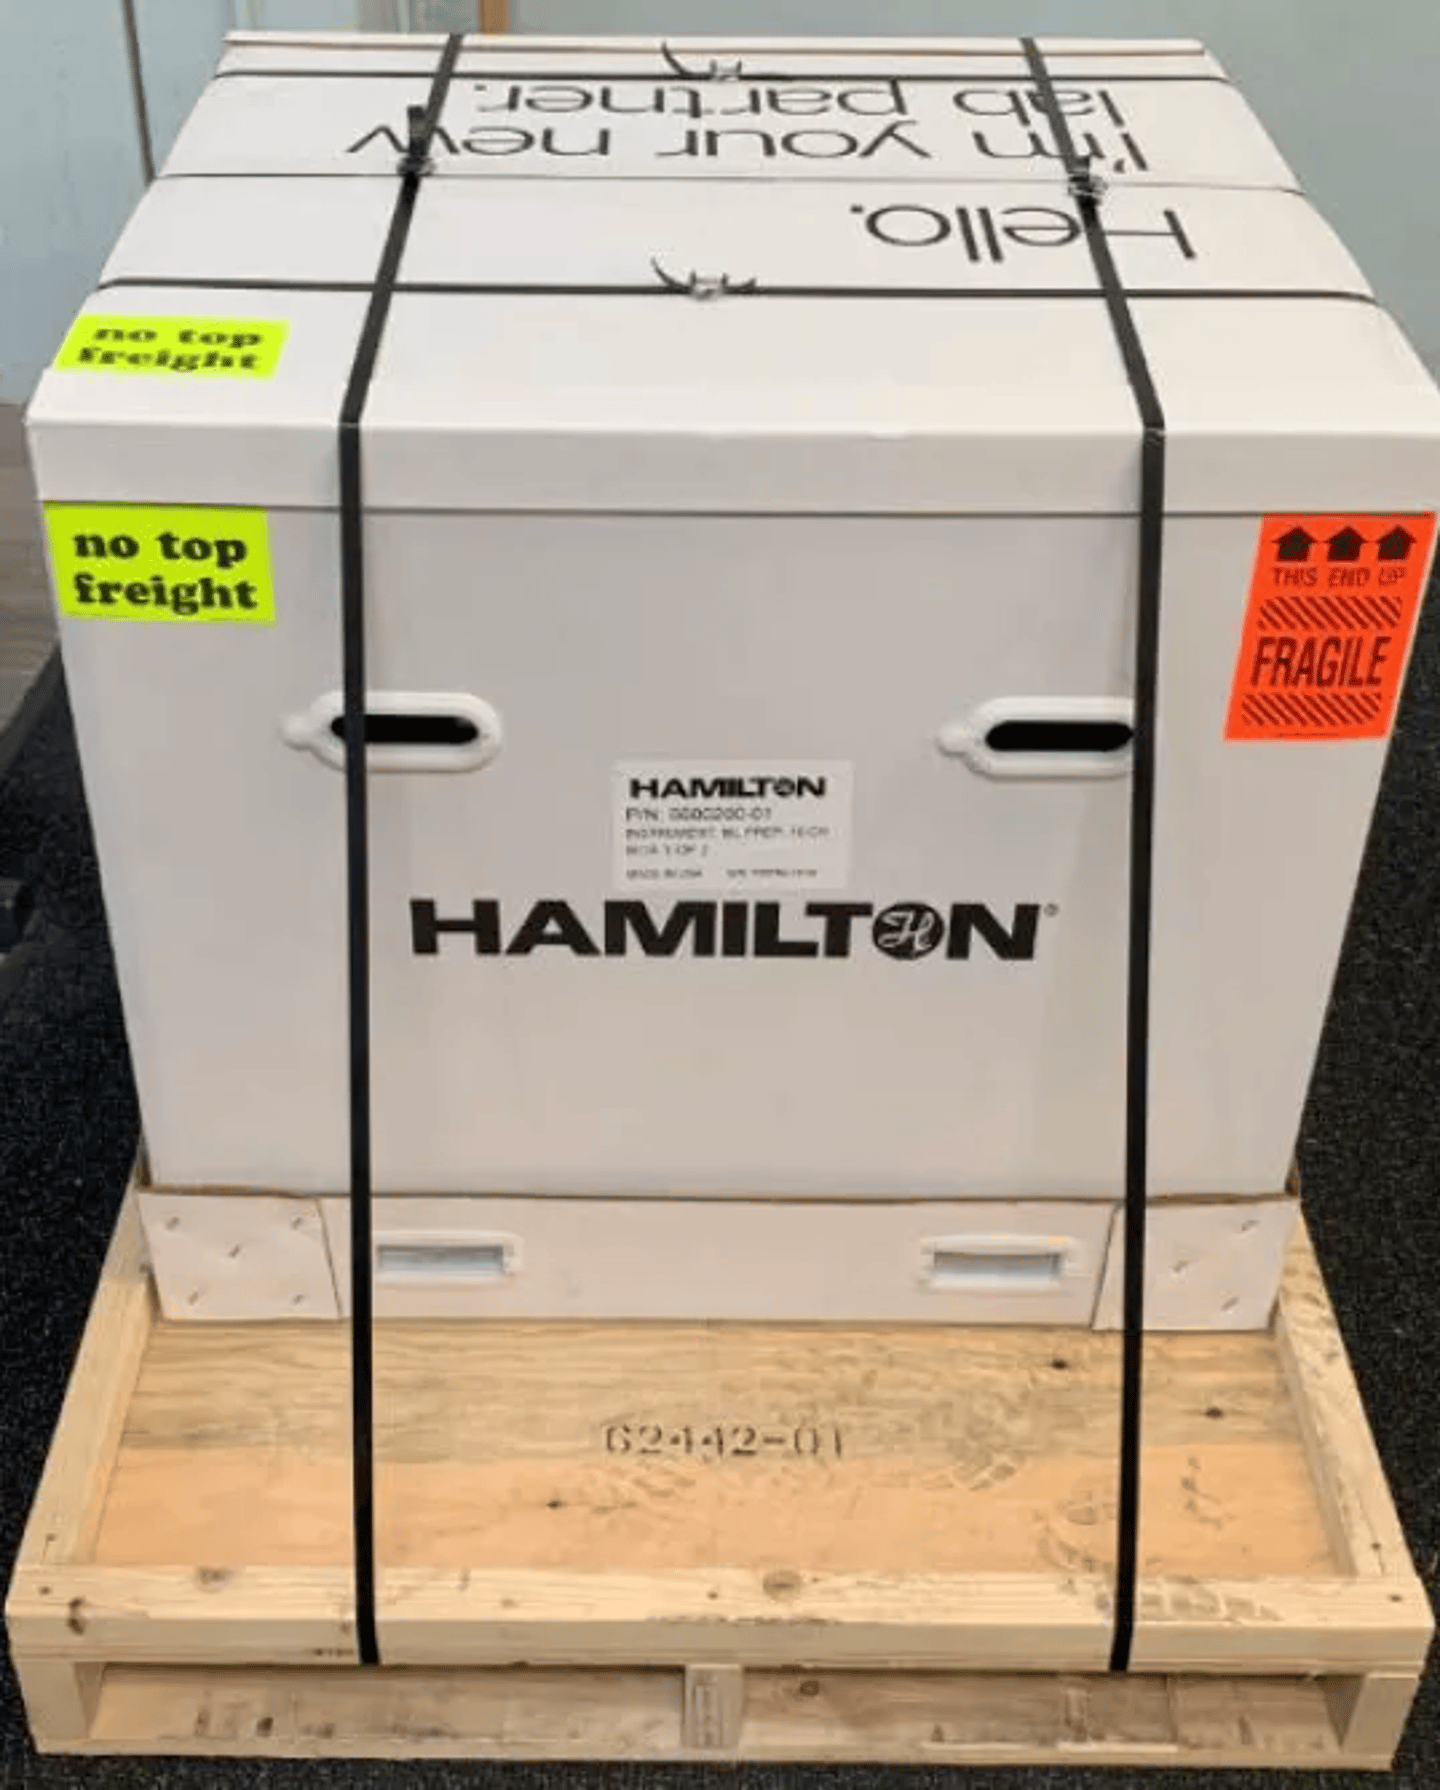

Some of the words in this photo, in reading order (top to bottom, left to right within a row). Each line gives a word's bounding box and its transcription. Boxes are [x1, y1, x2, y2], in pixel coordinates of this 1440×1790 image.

[473, 79, 907, 118] partner.
[953, 89, 1125, 127] lab
[655, 120, 932, 159] your
[850, 204, 1196, 263] Hello.
[93, 328, 158, 342] no
[178, 328, 262, 349] top
[78, 346, 258, 373] freight
[72, 533, 140, 559] no
[155, 531, 248, 569] top
[72, 572, 258, 616] freight
[1271, 566, 1318, 587] THIS
[1327, 566, 1372, 588] END
[1250, 636, 1392, 688] FRAGILE
[629, 775, 826, 799] HAMILTON
[606, 1424, 841, 1458] 62442-01
